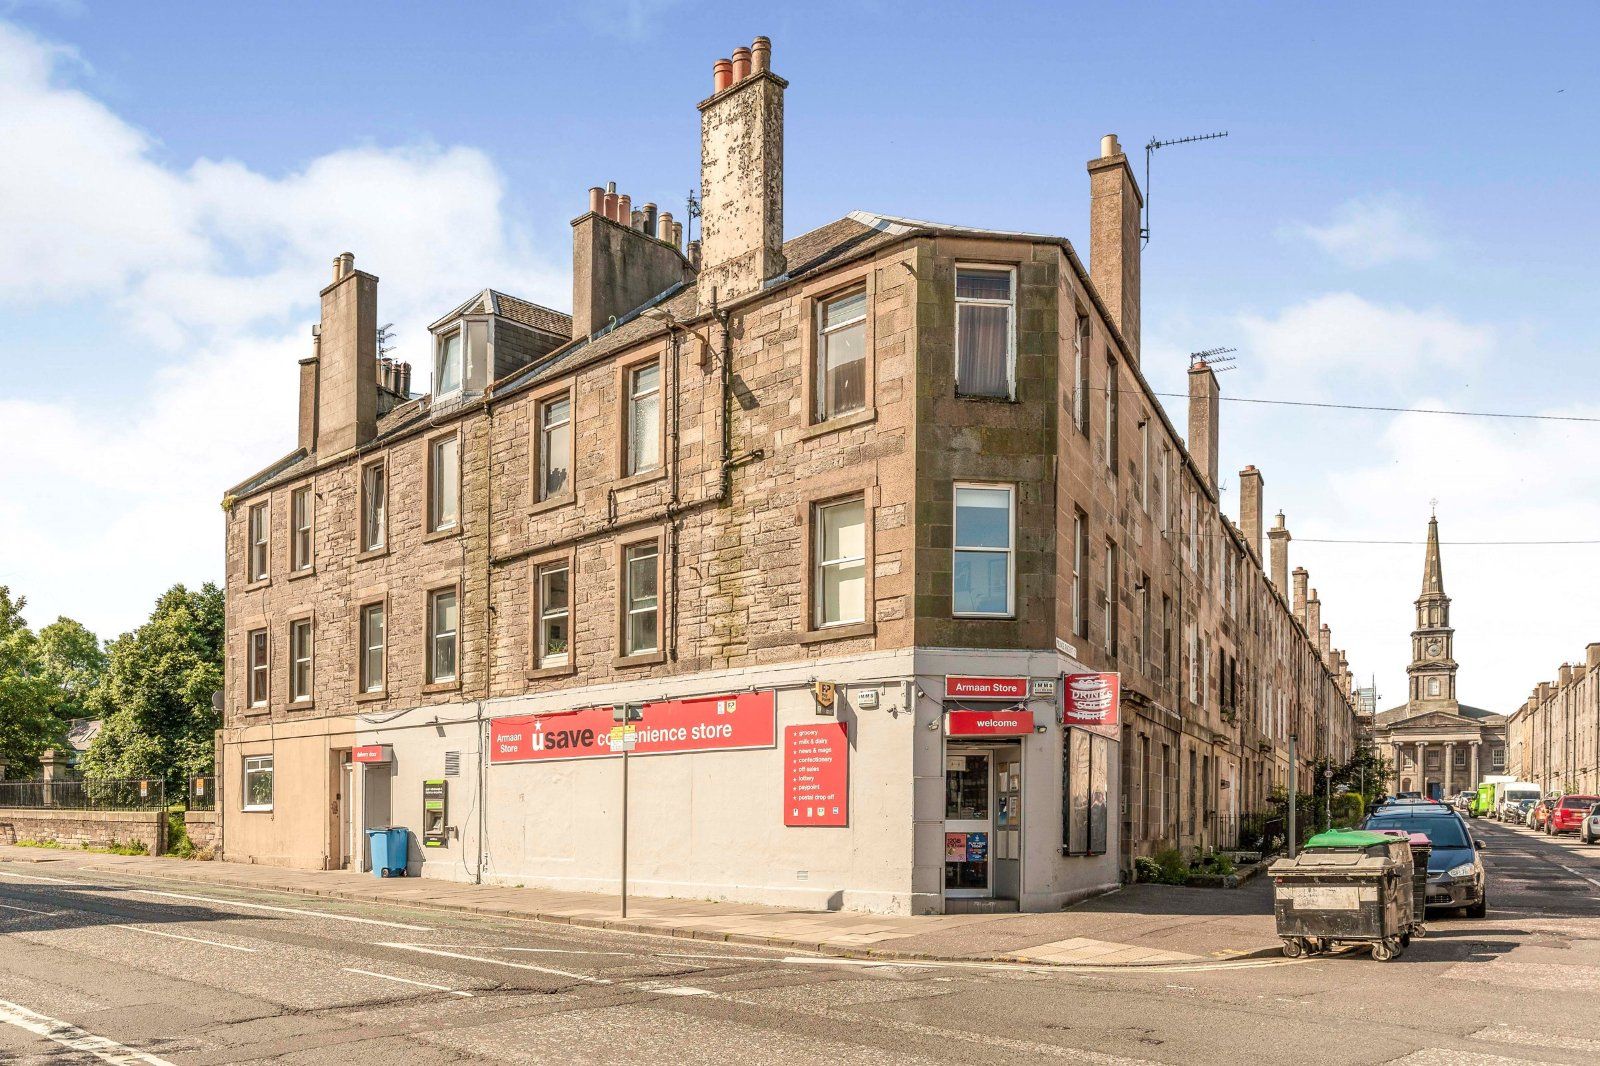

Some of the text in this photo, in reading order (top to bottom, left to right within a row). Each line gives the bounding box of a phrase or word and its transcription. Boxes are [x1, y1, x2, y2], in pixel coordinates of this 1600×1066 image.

[955, 683, 1018, 692] Armaan Store
[1072, 689, 1113, 700] DRINKS
[976, 718, 1018, 727] welcome
[496, 733, 522, 743] Armaan
[532, 727, 595, 752] usave
[691, 722, 733, 739] store
[500, 744, 518, 753] Store
[798, 784, 820, 792] paypoint
